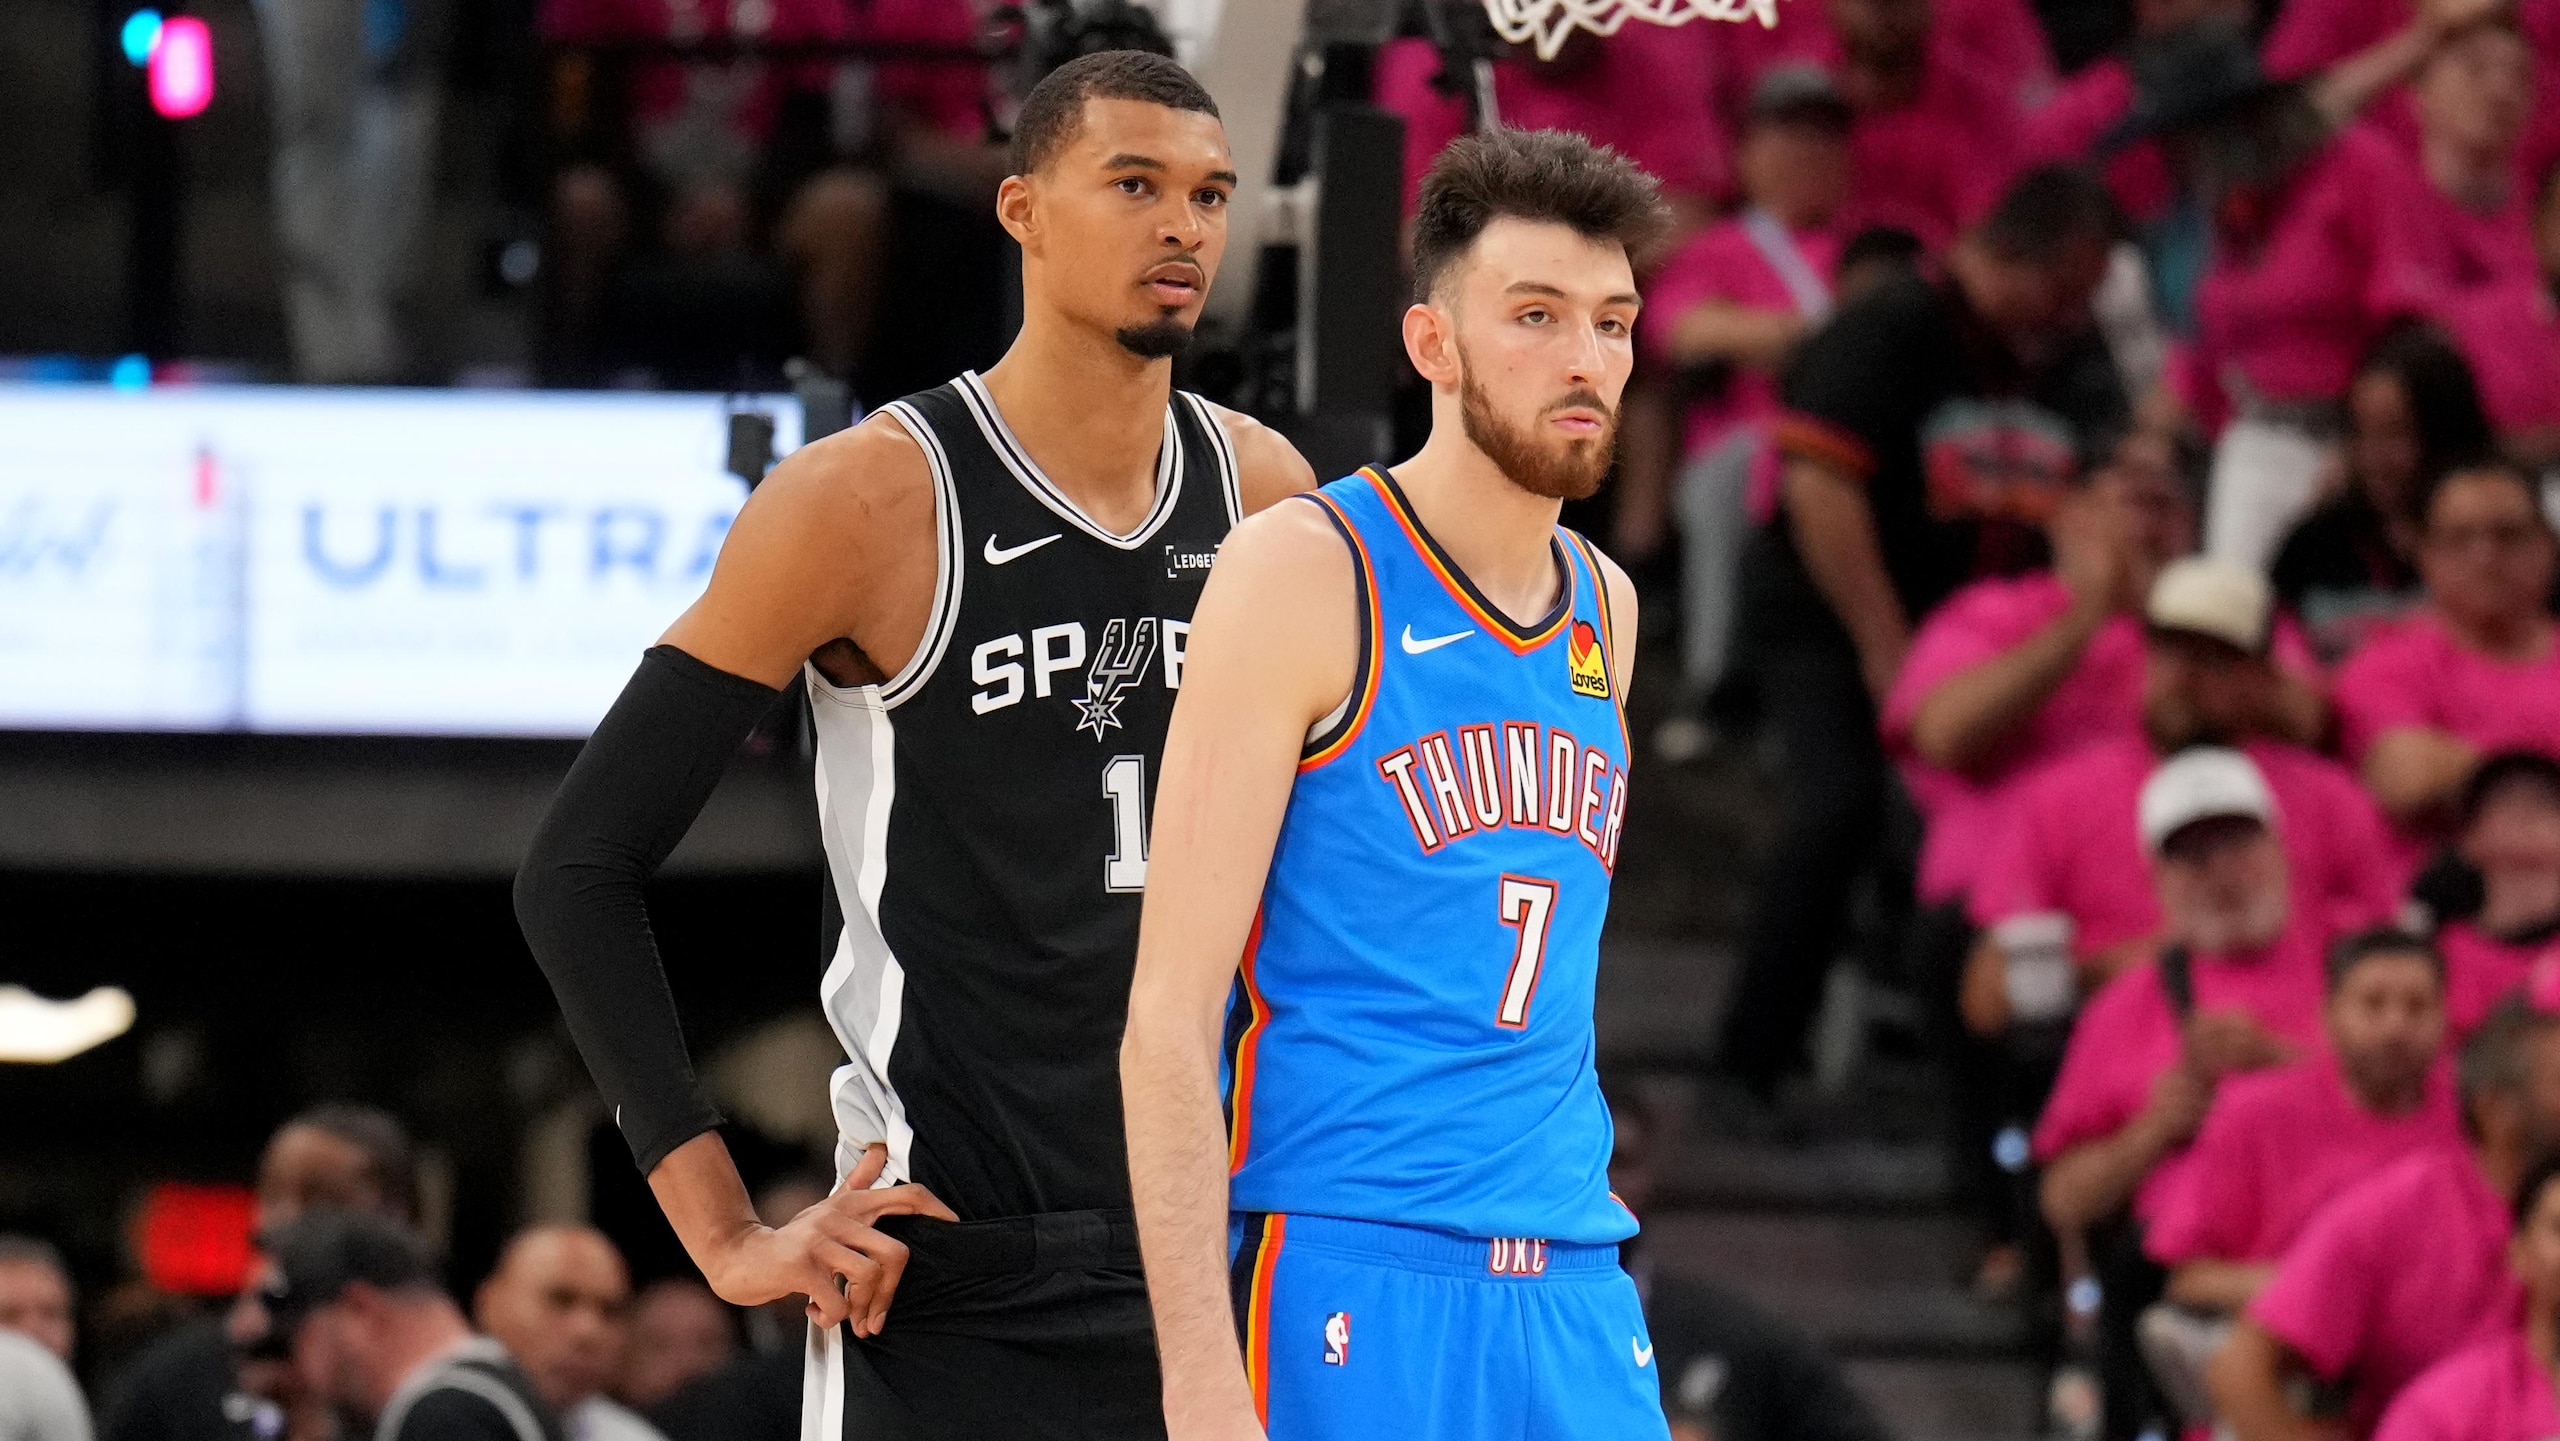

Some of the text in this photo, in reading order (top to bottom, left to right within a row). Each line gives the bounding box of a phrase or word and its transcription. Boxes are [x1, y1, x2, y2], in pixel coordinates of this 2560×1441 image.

[1102, 754, 1149, 893] 1
[1377, 720, 1628, 878] THUNDER
[1496, 873, 1558, 1030] 7
